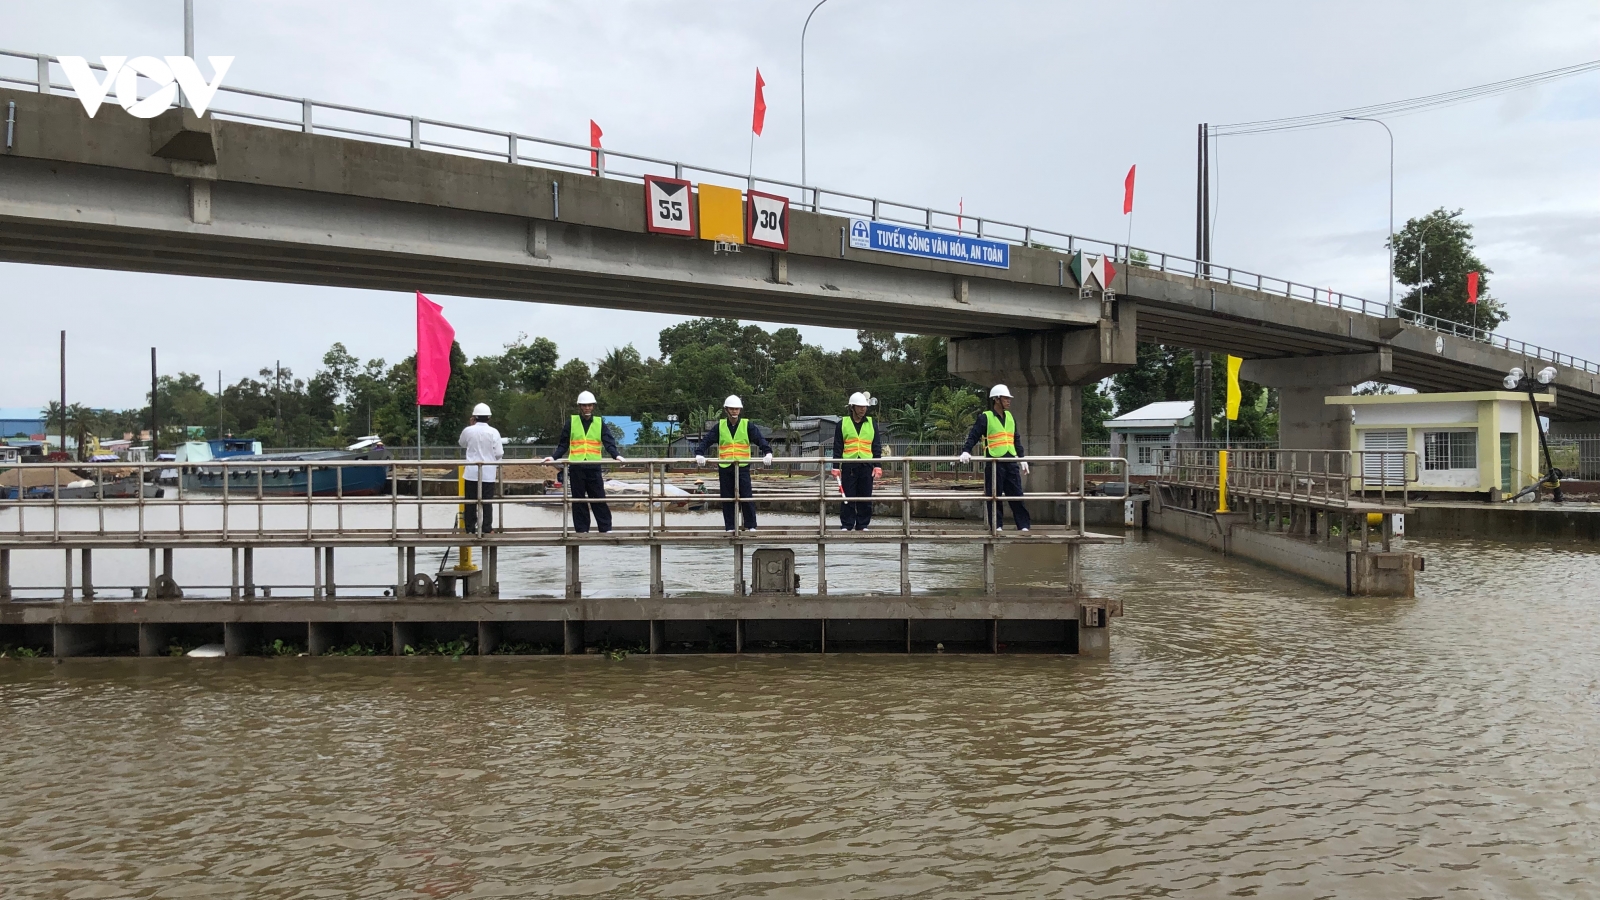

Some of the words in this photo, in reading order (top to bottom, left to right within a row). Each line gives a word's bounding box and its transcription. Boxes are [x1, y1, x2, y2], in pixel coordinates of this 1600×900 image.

[760, 209, 777, 231] 30
[876, 227, 906, 249] TUYẾN
[907, 232, 930, 253] SÔNG
[931, 236, 948, 256] VĂN
[949, 238, 969, 261] HÓA,
[970, 244, 981, 260] AN
[982, 244, 1003, 263] TOÀN
